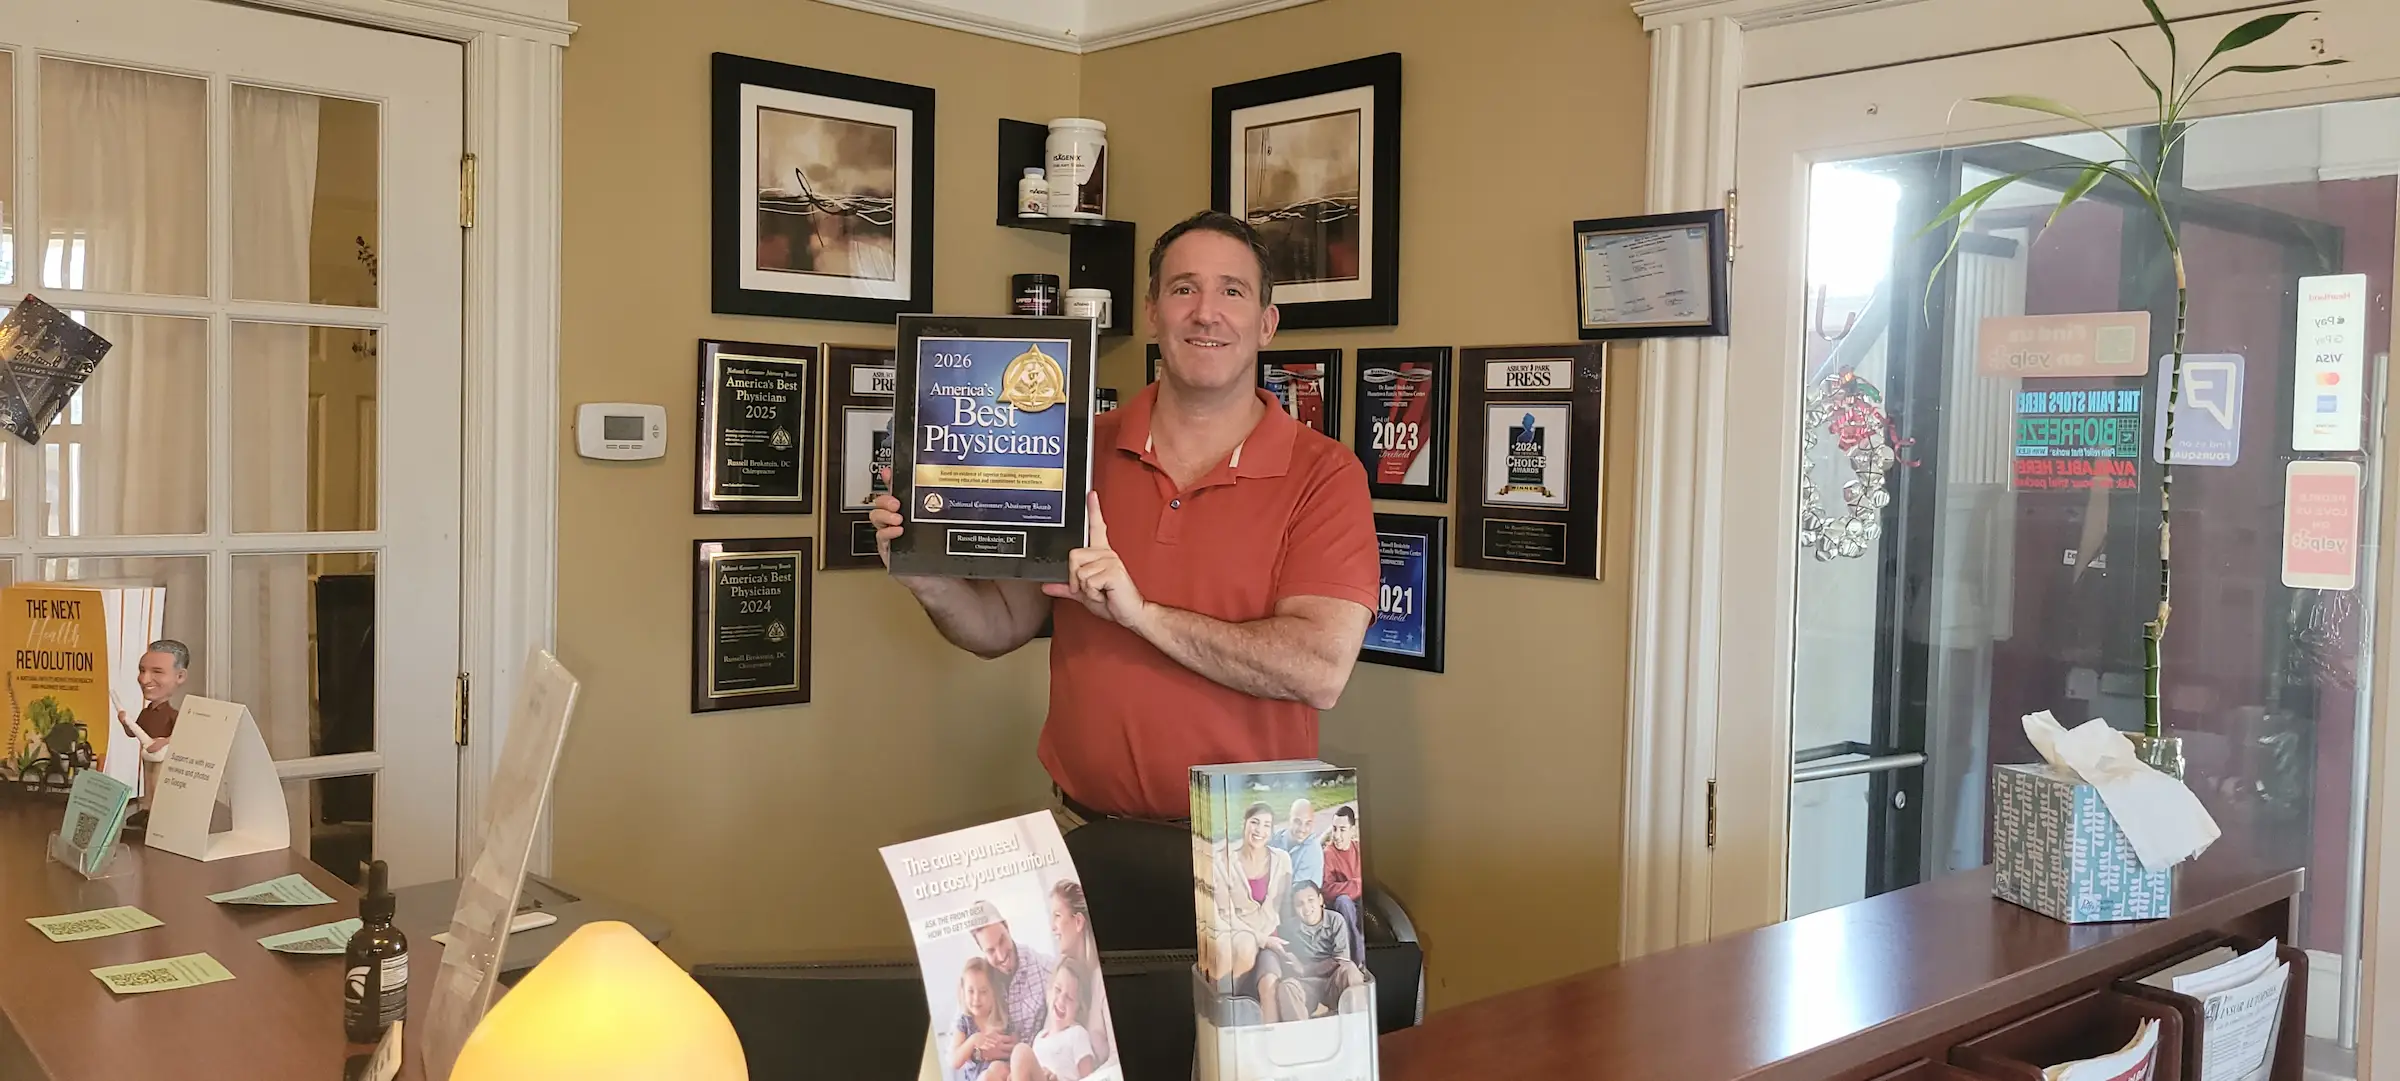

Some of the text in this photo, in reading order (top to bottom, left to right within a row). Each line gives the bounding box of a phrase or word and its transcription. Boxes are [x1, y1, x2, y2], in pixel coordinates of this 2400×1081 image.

[934, 353, 972, 368] 2026
[726, 376, 798, 391] America's Best
[1506, 372, 1550, 386] PRESS
[736, 390, 786, 402] Physicians
[930, 382, 994, 397] America's
[746, 405, 777, 419] 2025
[951, 396, 1018, 427] Best
[924, 425, 1060, 460] Physicians
[1372, 422, 1418, 450] 2023
[1515, 442, 1537, 451] 2024
[1506, 455, 1546, 468] CHOICE
[720, 571, 792, 585] America's Best
[731, 585, 782, 598] Physicians
[740, 600, 771, 614] 2024
[1378, 584, 1412, 615] 021
[26, 600, 80, 619] THE NEXT
[16, 650, 93, 671] REVOLUTION
[171, 752, 188, 763] Support
[902, 833, 1020, 876] The care you need
[913, 848, 1059, 900] at a cost you can afford.
[925, 920, 936, 928] ASK
[937, 916, 949, 924] THE
[950, 910, 968, 920] FRONT
[928, 929, 942, 939] HOW
[952, 923, 963, 932] GET
